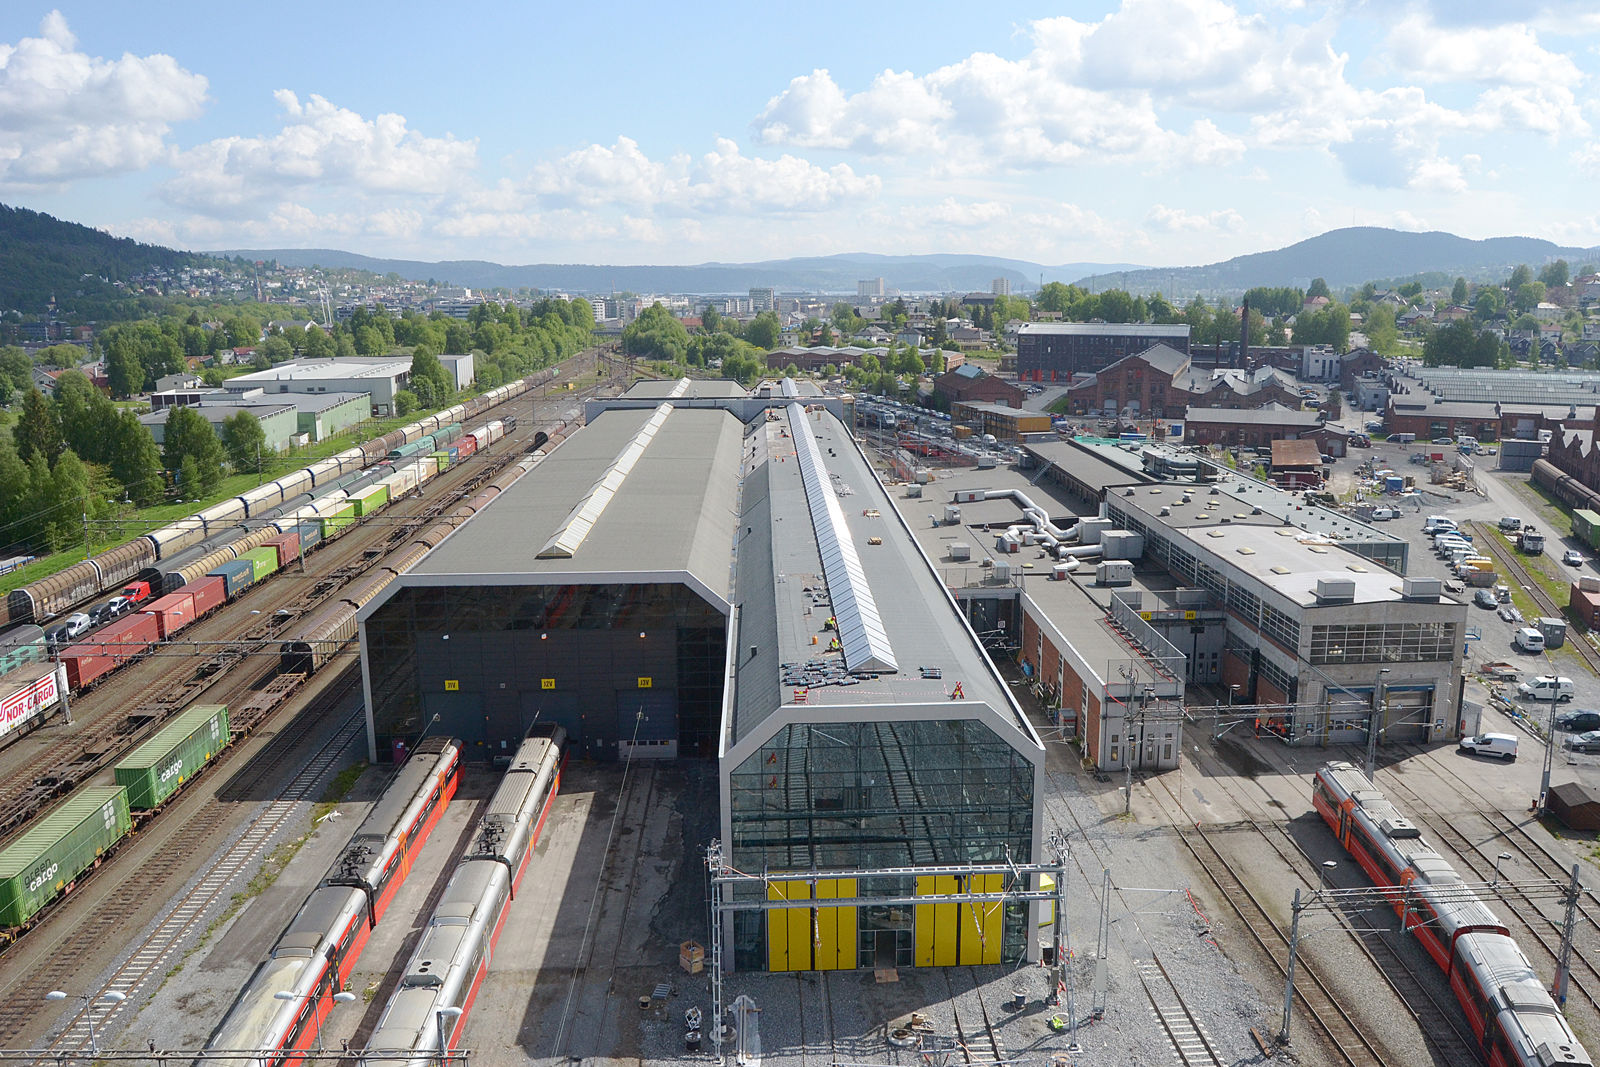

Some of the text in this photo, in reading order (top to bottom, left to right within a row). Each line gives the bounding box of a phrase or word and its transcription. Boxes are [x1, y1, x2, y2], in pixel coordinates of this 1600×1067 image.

[161, 760, 183, 782] cargo
[24, 858, 52, 889] green
[30, 863, 58, 892] cargo
